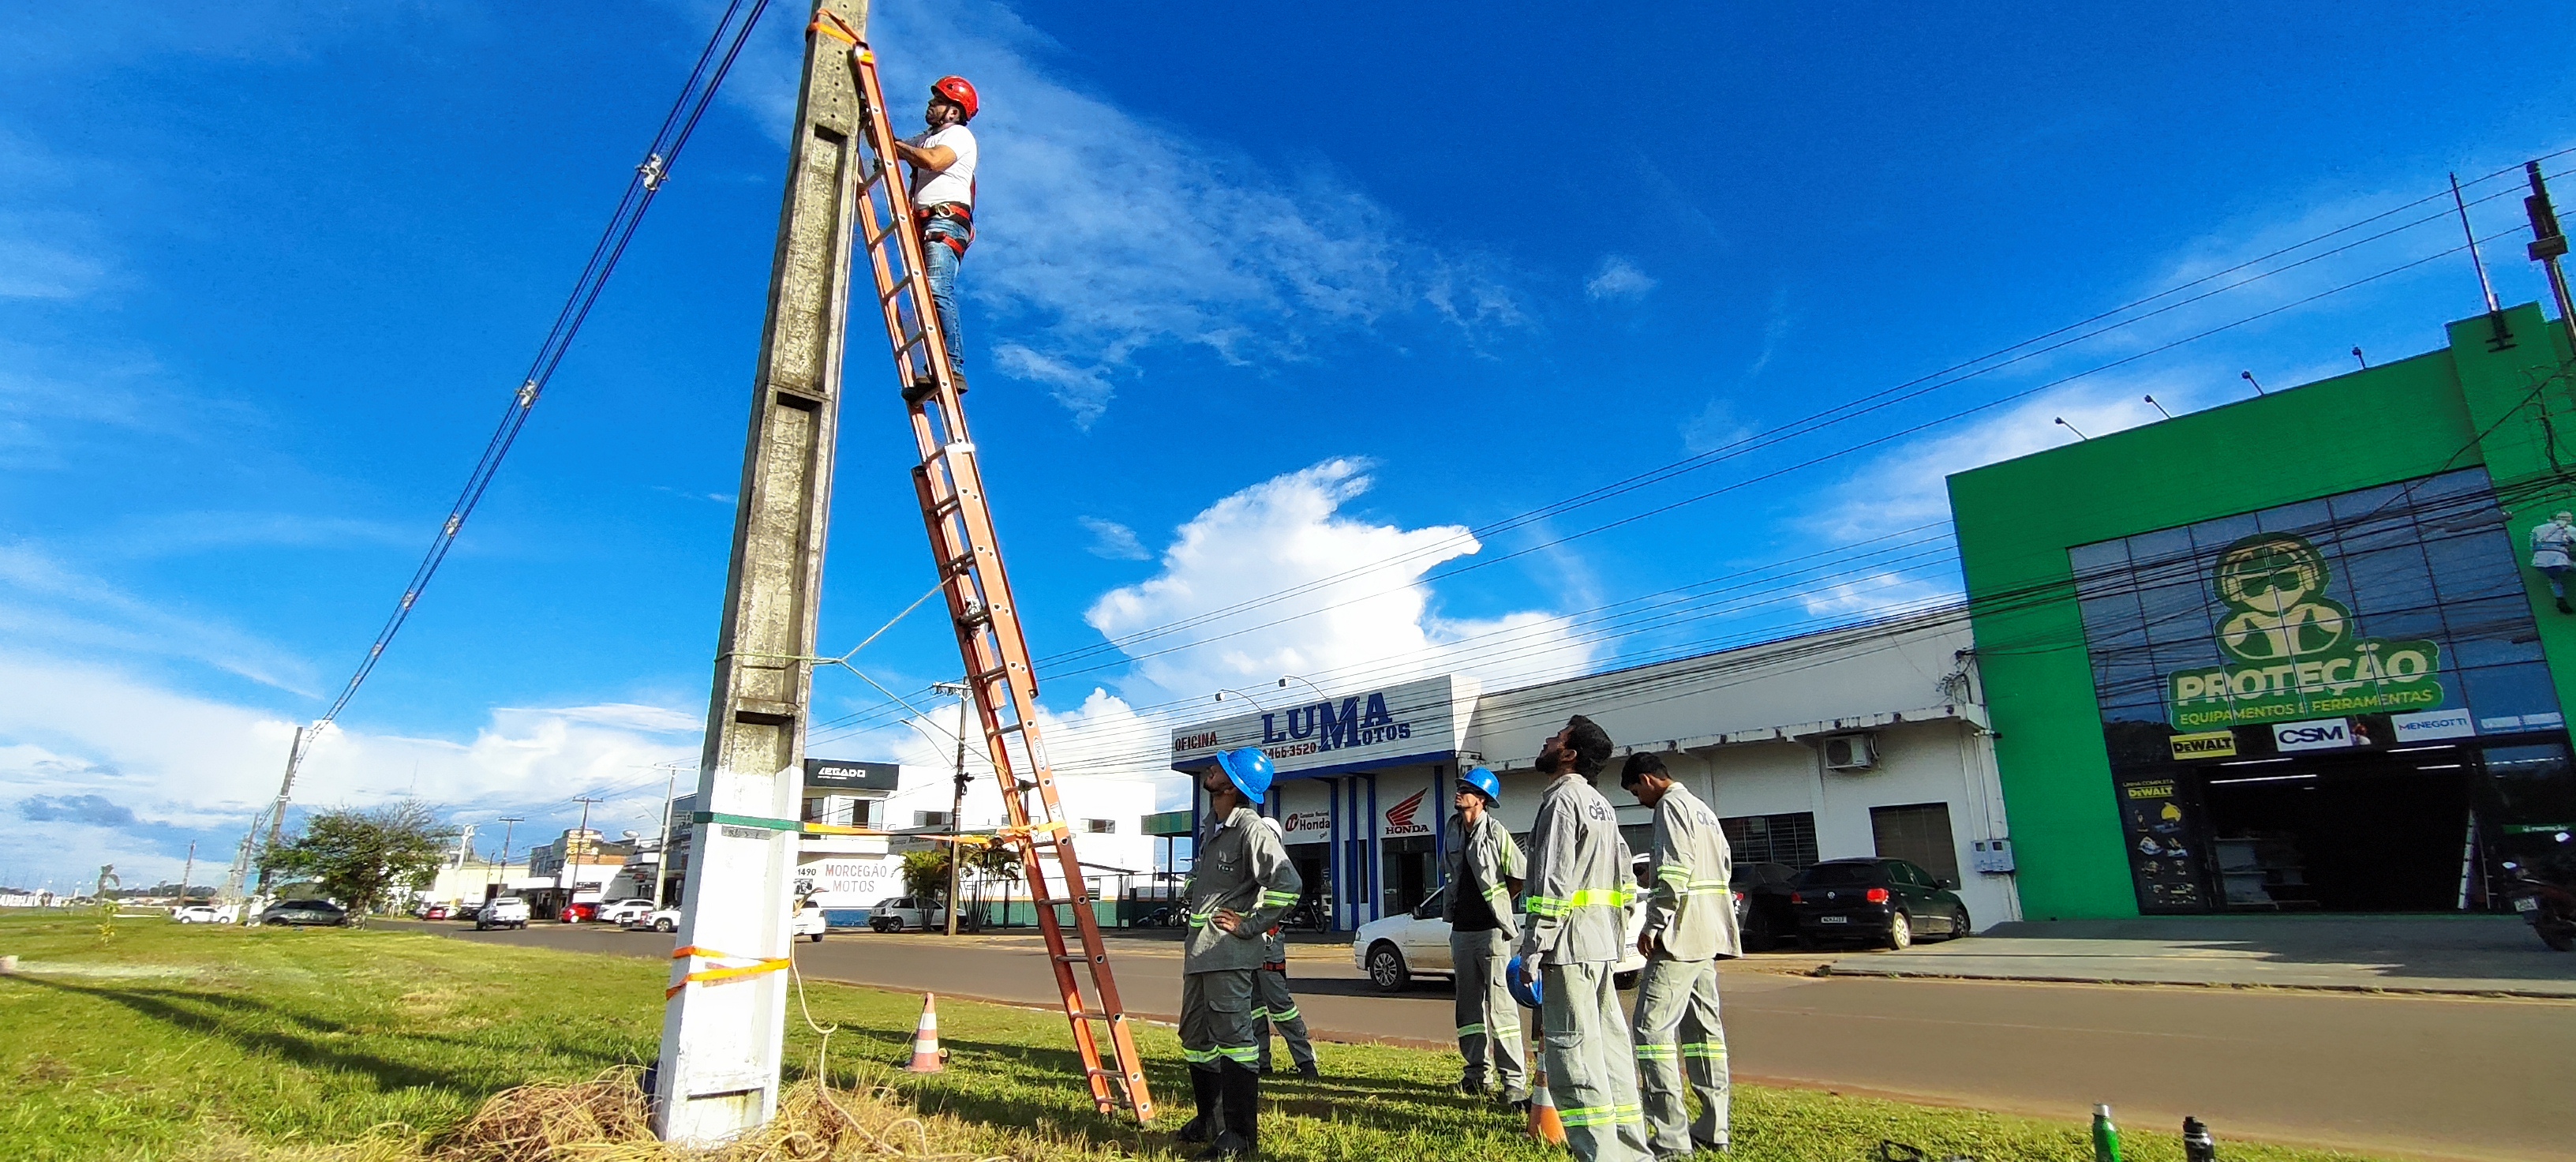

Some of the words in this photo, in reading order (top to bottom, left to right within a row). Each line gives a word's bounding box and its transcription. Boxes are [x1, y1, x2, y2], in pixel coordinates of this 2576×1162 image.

[2177, 642, 2428, 707] PROTEÇÃO
[2179, 703, 2294, 725] EQUIPAMENTOS
[2312, 689, 2434, 711] FERRAMENTAS
[1261, 692, 1393, 752] LUMA
[2398, 718, 2467, 731] MENEGOTTI
[1174, 730, 1218, 752] OFICINA
[2278, 725, 2344, 744] CSM
[818, 767, 866, 778] LEGADO
[1299, 817, 1331, 831] Honda
[1385, 824, 1430, 835] HONDA
[825, 863, 887, 878] MORCEGÃO
[833, 879, 874, 893] MOTOS
